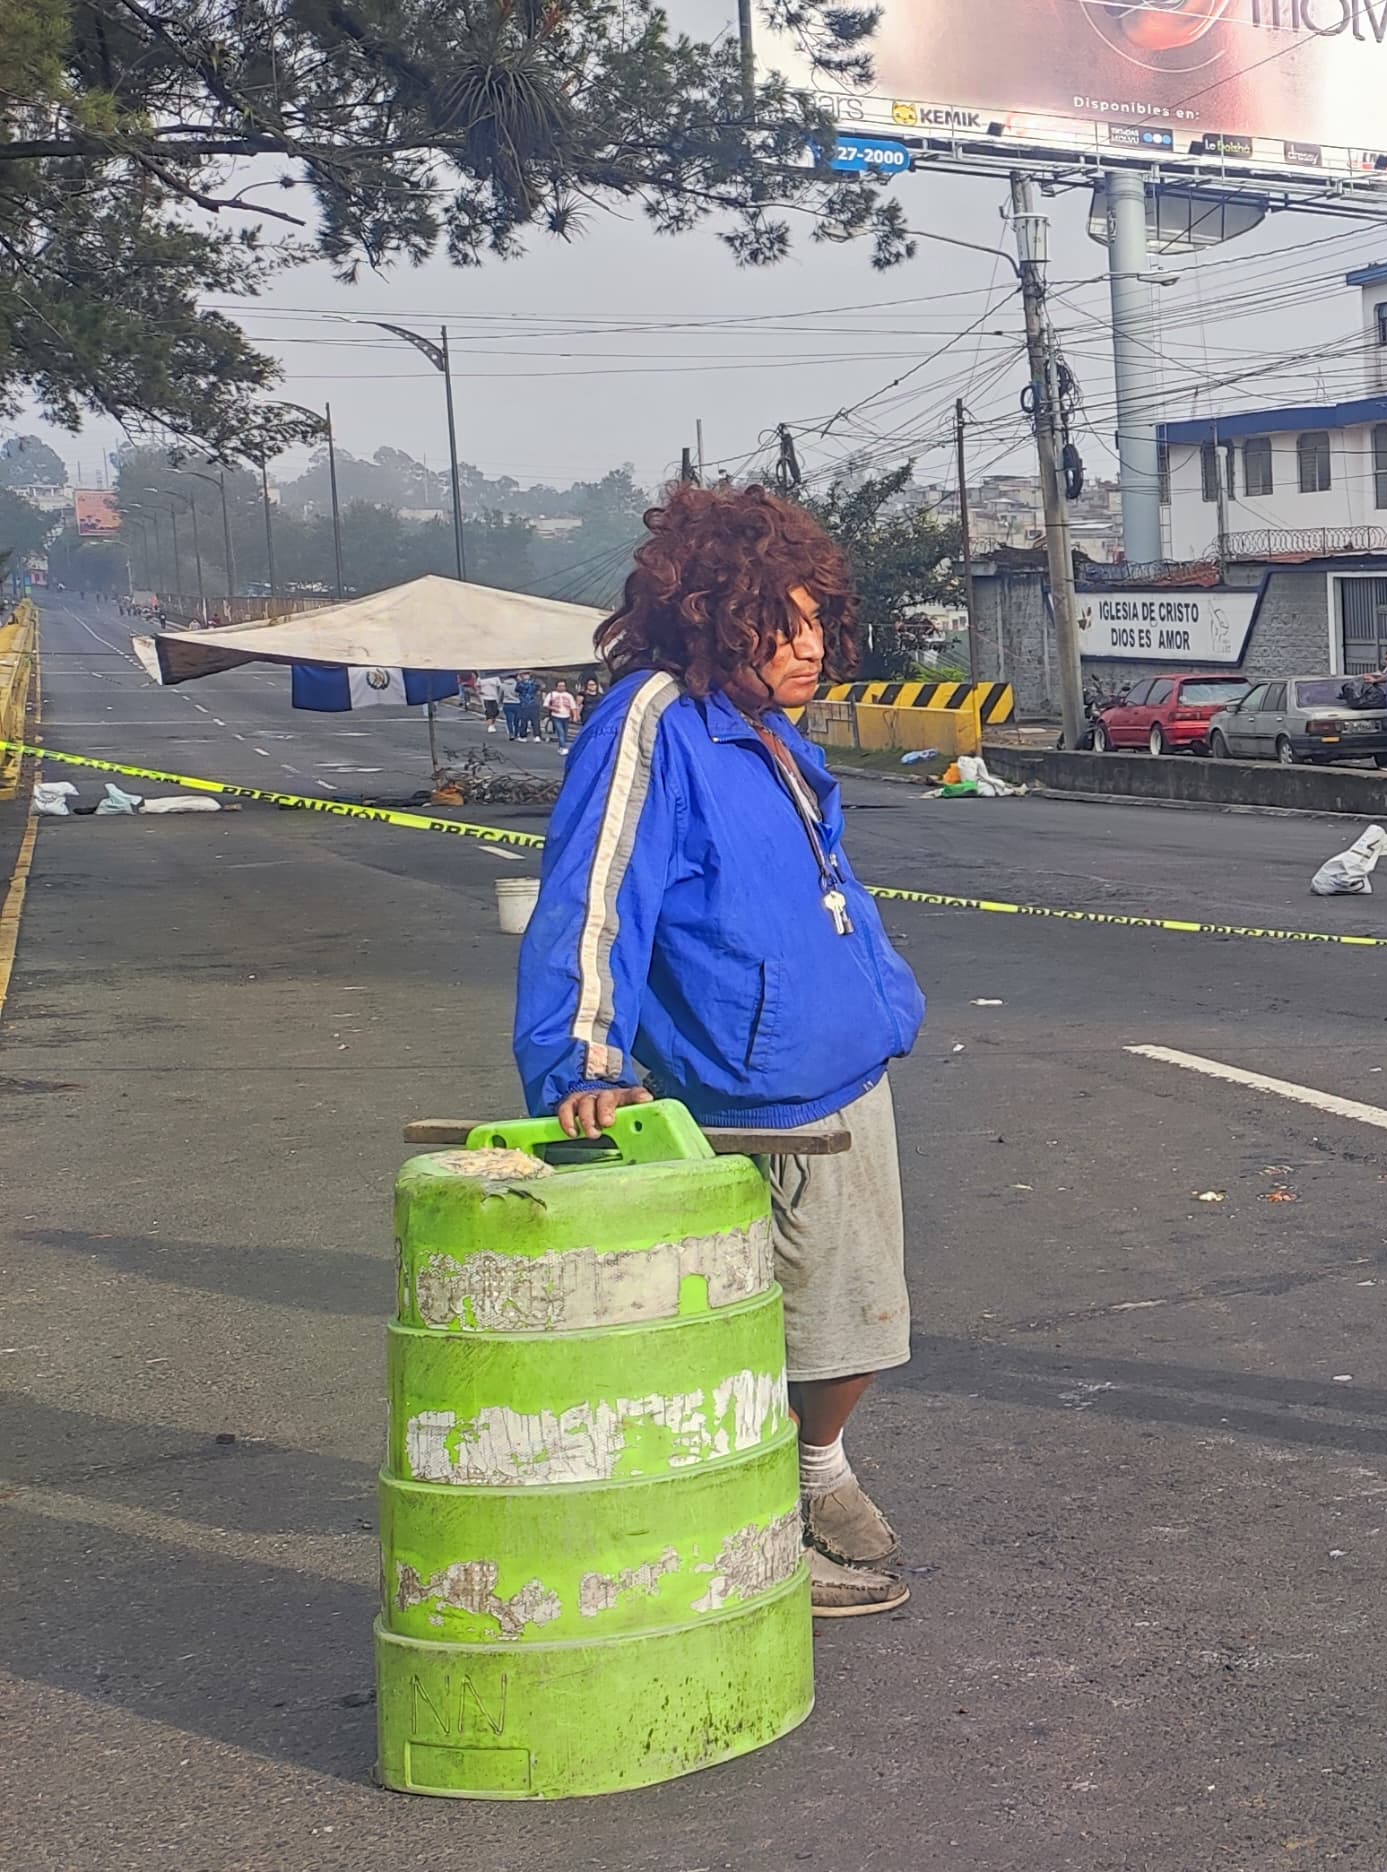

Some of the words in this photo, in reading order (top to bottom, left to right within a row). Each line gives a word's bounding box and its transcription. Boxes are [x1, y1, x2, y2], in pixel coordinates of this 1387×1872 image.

[919, 108, 981, 128] KEMIK
[1073, 96, 1170, 117] Disponibles
[1175, 107, 1200, 120] en:
[1099, 601, 1139, 621] IGLESIA
[1141, 602, 1156, 621] DE
[1158, 602, 1200, 623] CRISTO
[1110, 627, 1136, 648] DIOS
[1138, 628, 1152, 648] ES
[1158, 629, 1191, 650] AMOR
